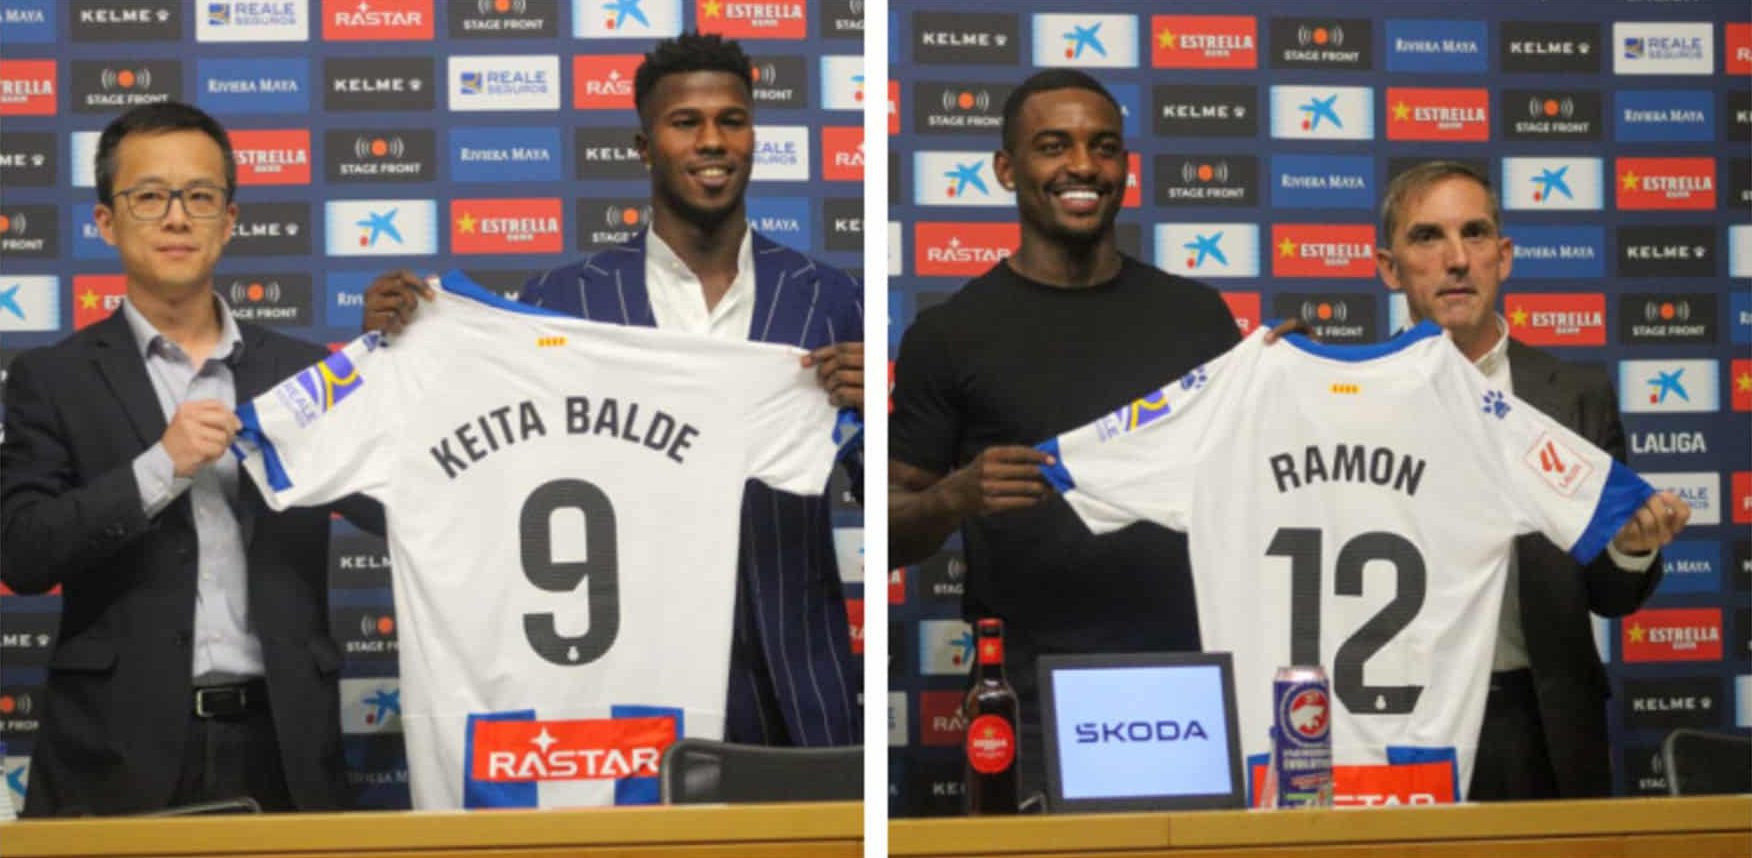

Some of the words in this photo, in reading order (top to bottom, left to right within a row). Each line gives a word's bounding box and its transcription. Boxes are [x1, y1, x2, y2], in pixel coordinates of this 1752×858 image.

[234, 2, 295, 16] REALE
[725, 3, 802, 19] ESTRELLA
[5, 10, 44, 22] MAYA
[80, 10, 150, 23] KELME
[334, 12, 422, 27] RASTAR
[463, 19, 501, 30] STAGE
[503, 19, 544, 30] FRONT
[922, 32, 990, 46] KELME
[1180, 34, 1254, 50] ESTRELLA
[1395, 38, 1440, 53] RIVIERA
[1442, 40, 1478, 53] MAYA
[1647, 37, 1702, 50] REALE
[1510, 41, 1573, 54] KELME
[1284, 50, 1319, 61] STAGE
[1321, 51, 1360, 62] FRONT
[487, 71, 547, 84] REALE
[208, 79, 256, 92] RIVIERA
[259, 80, 298, 92] MAYA
[334, 79, 404, 91] KELME
[86, 94, 126, 105] STAGE
[752, 89, 793, 100] FRONT
[1162, 105, 1229, 118] KELME
[1414, 107, 1486, 123] ESTRELLA
[1624, 109, 1668, 123] RIVIERA
[1670, 110, 1705, 123] MAYA
[928, 115, 966, 127] STAGE
[1515, 121, 1551, 133] STAGE
[1552, 121, 1589, 133] FRONT
[460, 148, 509, 161] RIVIERA
[511, 149, 550, 161] MAYA
[340, 164, 380, 175] STAGE
[381, 163, 421, 174] FRONT
[1280, 173, 1327, 187] RIVIERA
[1329, 175, 1365, 189] MAYA
[1643, 176, 1713, 191] ESTRELLA
[1168, 187, 1205, 198] STAGE
[1207, 187, 1245, 198] FRONT
[480, 217, 558, 234] ESTRELLA
[760, 217, 800, 230] MAYA
[2, 239, 44, 250] FRONT
[1300, 242, 1373, 259] ESTRELLA
[1559, 246, 1595, 259] MAYA
[1627, 245, 1689, 258] KELME
[256, 308, 298, 319] FRONT
[1531, 311, 1602, 327] ESTRELLA
[1325, 326, 1365, 337] FRONT
[1632, 326, 1666, 337] STAGE
[1668, 325, 1705, 336] FRONT
[430, 400, 547, 479] KEITA
[565, 395, 700, 464] BALDE
[1631, 432, 1707, 453] LALIGA
[1269, 443, 1426, 496] RAMON
[519, 477, 621, 666] 9
[1676, 560, 1712, 573] MAYA
[1265, 527, 1427, 715] 12
[1648, 626, 1719, 643] ESTRELLA
[346, 641, 385, 652] STAGE
[1633, 697, 1697, 710] KELME
[488, 746, 662, 778] RASTAR
